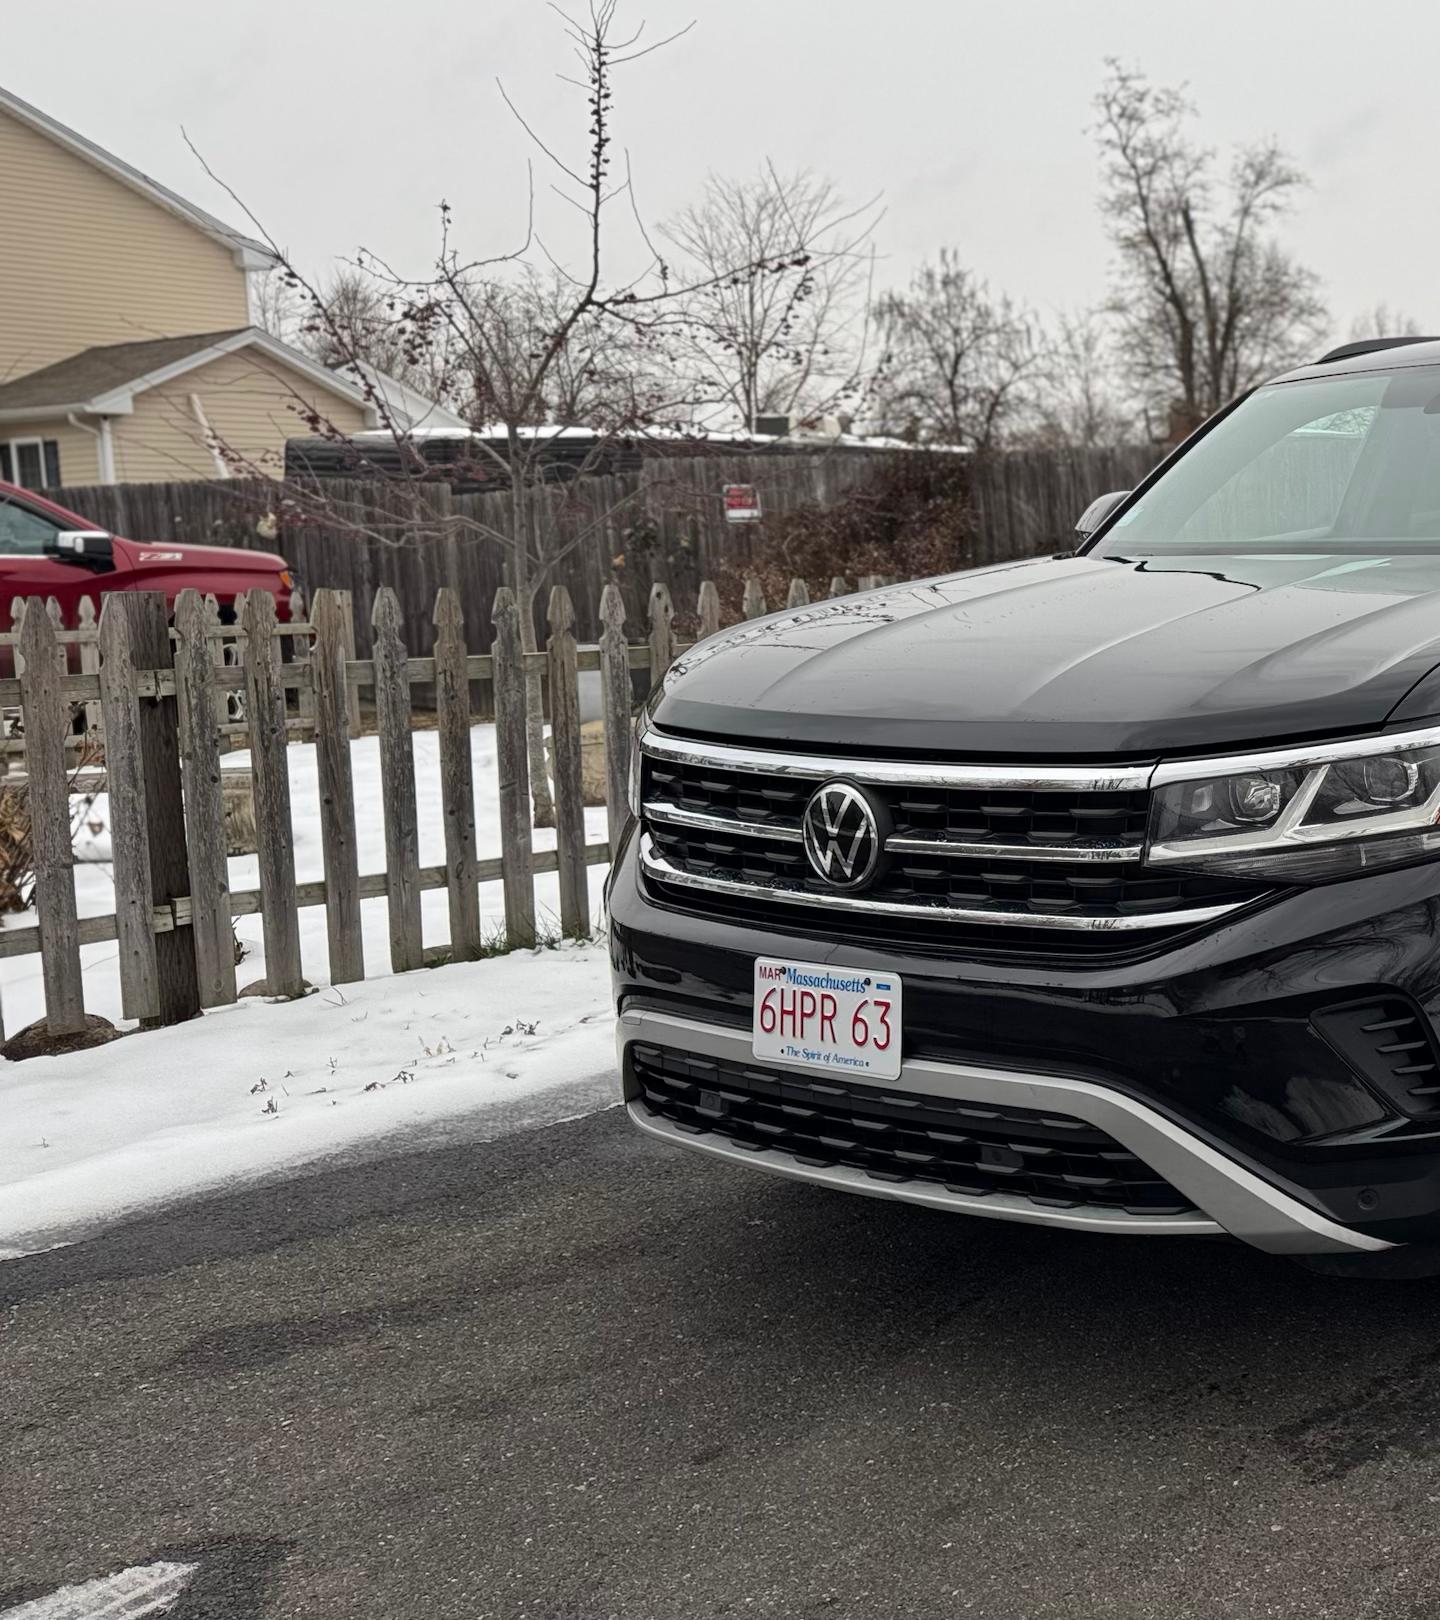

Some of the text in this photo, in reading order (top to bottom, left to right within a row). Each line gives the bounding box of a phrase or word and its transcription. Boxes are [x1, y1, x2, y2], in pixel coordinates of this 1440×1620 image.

[759, 966, 781, 980] MAR
[786, 967, 866, 993] Massachusetts
[760, 987, 891, 1050] 6HPR 63
[786, 1046, 864, 1067] The Spirit of America
